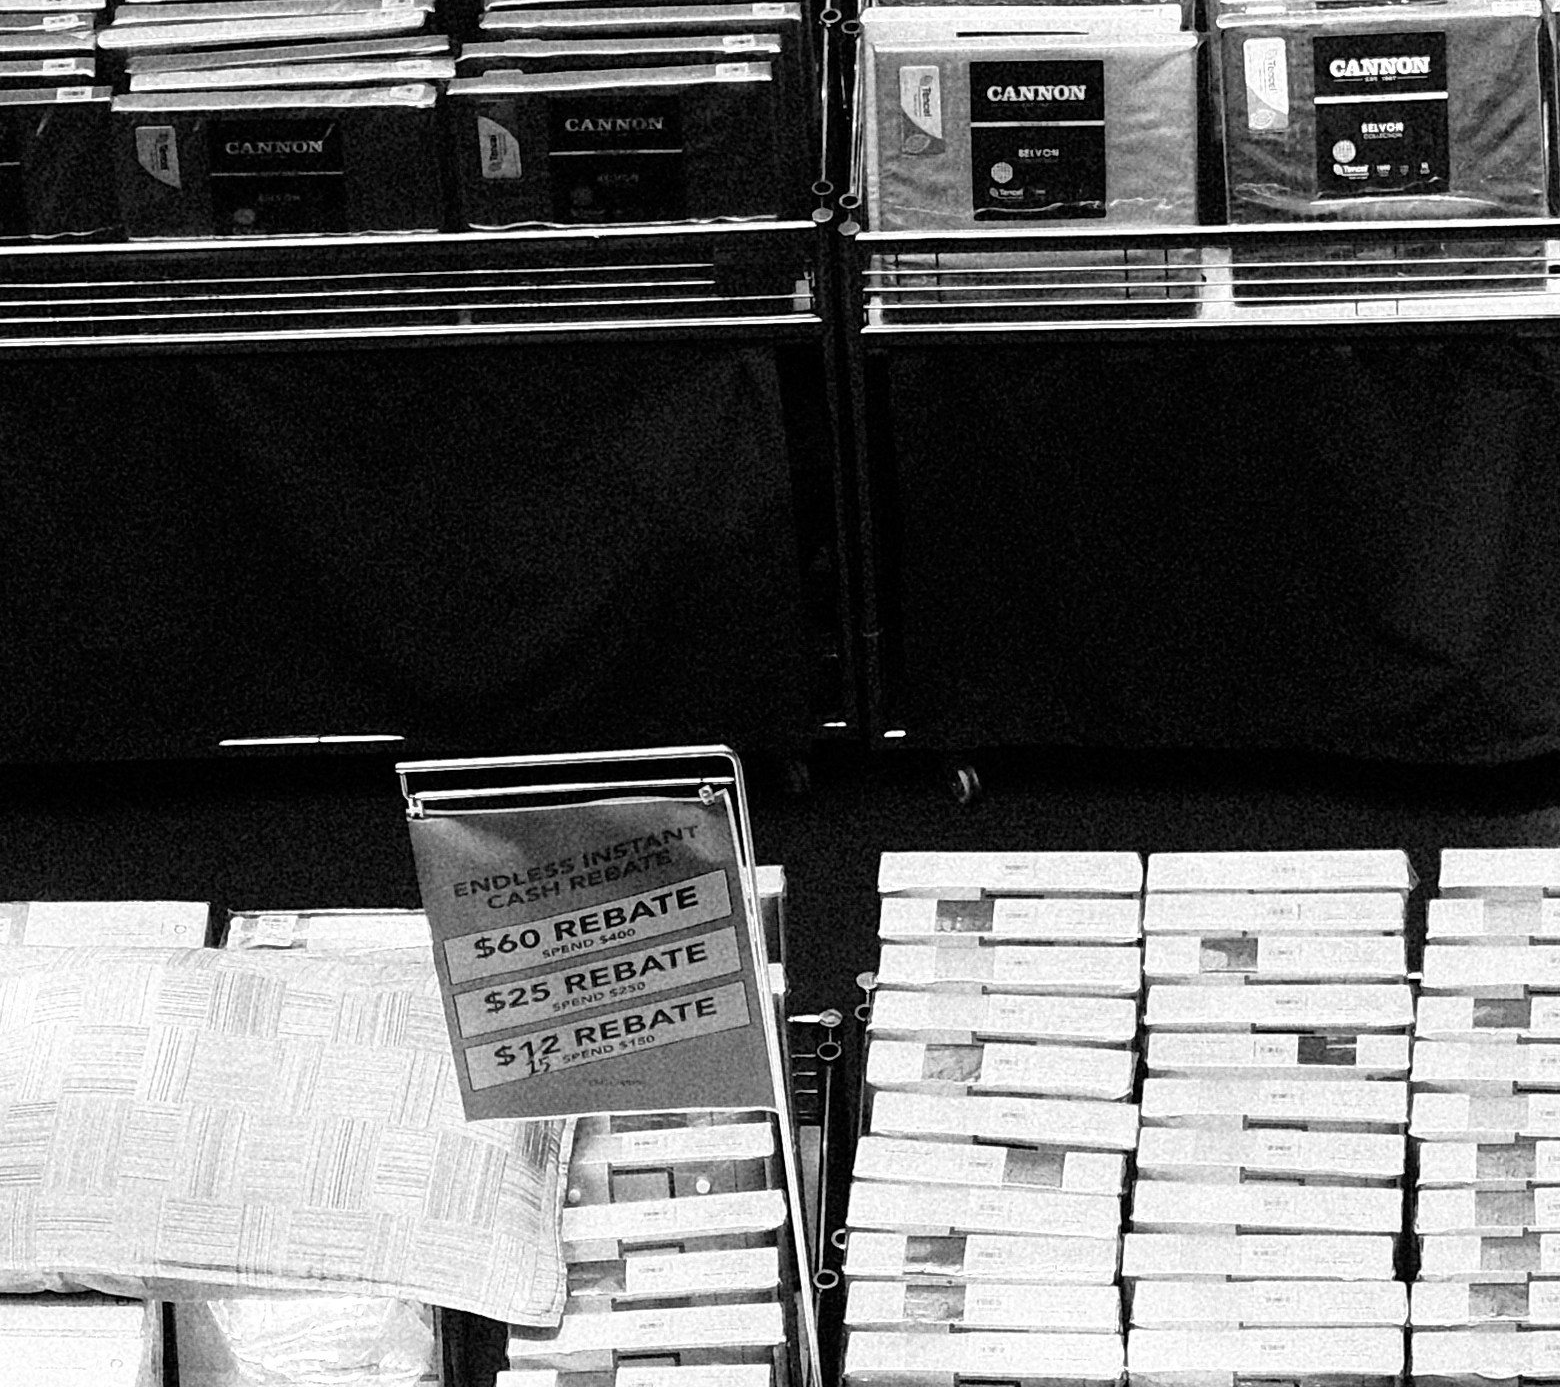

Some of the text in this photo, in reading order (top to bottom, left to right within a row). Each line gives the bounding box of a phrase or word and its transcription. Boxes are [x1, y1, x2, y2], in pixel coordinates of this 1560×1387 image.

[1329, 55, 1431, 78] CANNON
[921, 87, 933, 118] Tencel
[986, 85, 1087, 102] CANNON
[565, 117, 664, 132] CANNON
[1361, 122, 1404, 134] BELVON
[225, 140, 324, 155] CANNON
[1018, 148, 1059, 158] BELVON
[453, 825, 699, 899] ENDLESS INSTANT
[487, 851, 672, 910] CASH REBATE
[475, 884, 699, 960] $60 REBATE
[542, 928, 636, 959] SPEND $400
[484, 941, 708, 1014] $25 REBATE
[552, 981, 646, 1013] SPEND $250
[495, 996, 718, 1068] $12 REBATE
[561, 1044, 614, 1064] SPEND
